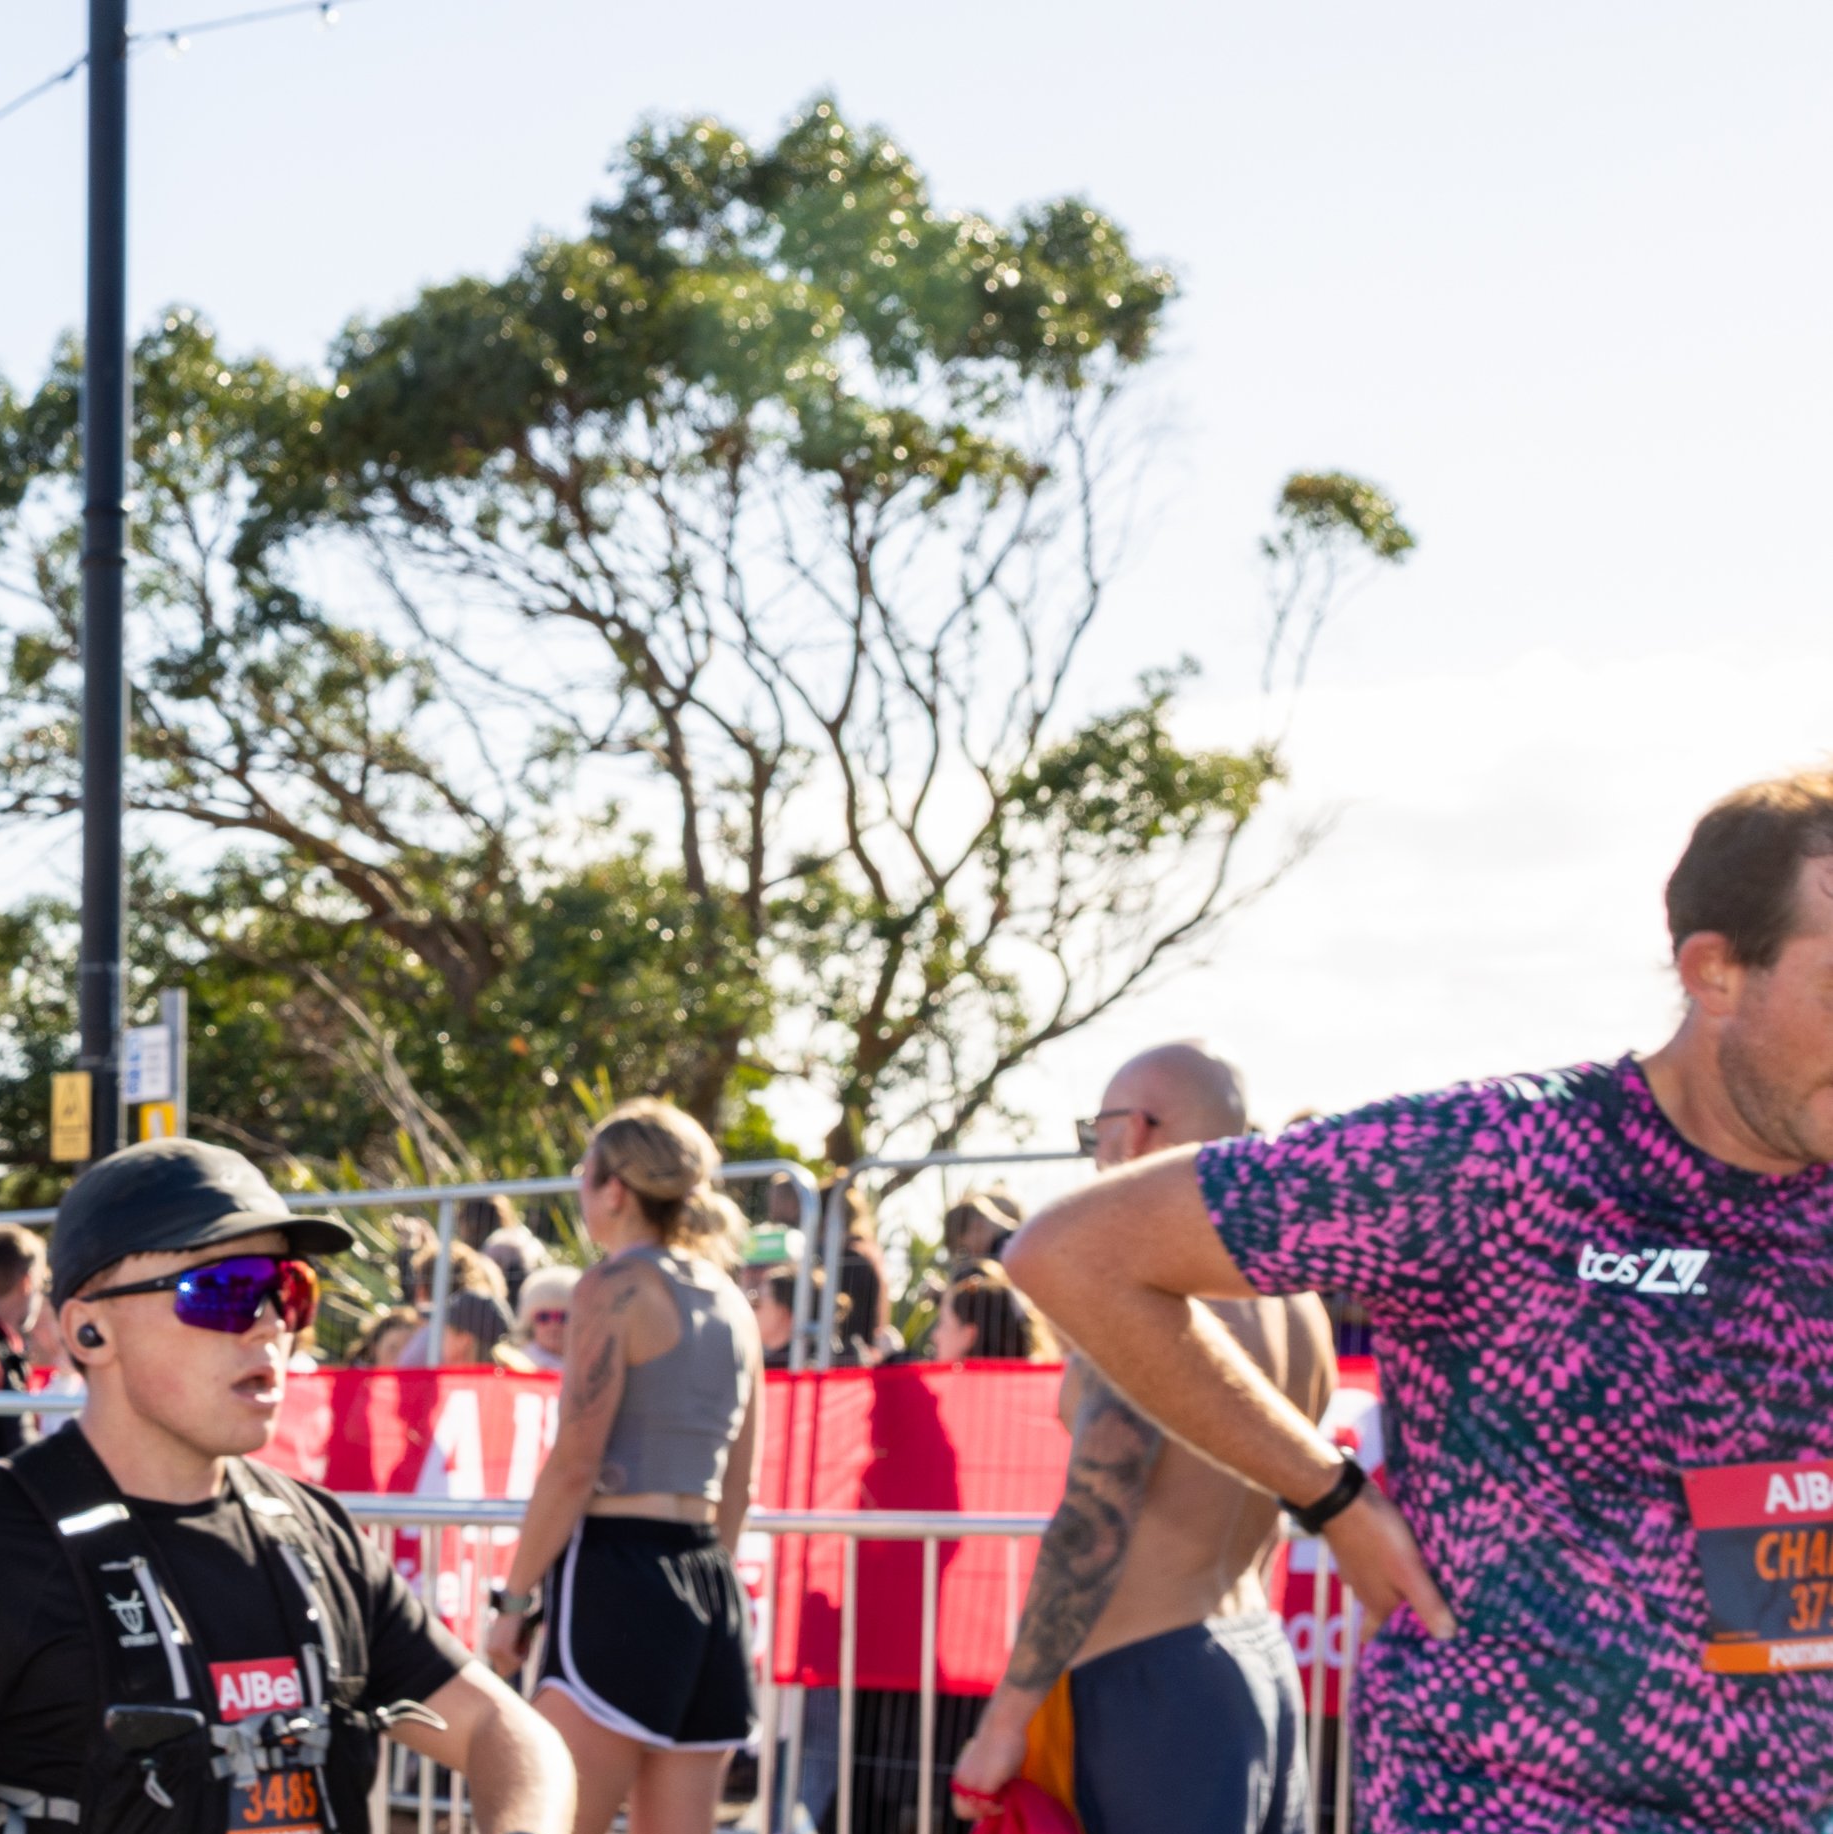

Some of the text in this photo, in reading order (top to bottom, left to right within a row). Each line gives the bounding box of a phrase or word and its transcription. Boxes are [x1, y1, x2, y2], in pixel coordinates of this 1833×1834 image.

[1764, 1471, 1833, 1514] AJB
[1754, 1529, 1833, 1581] CHA
[1789, 1582, 1833, 1632] 37
